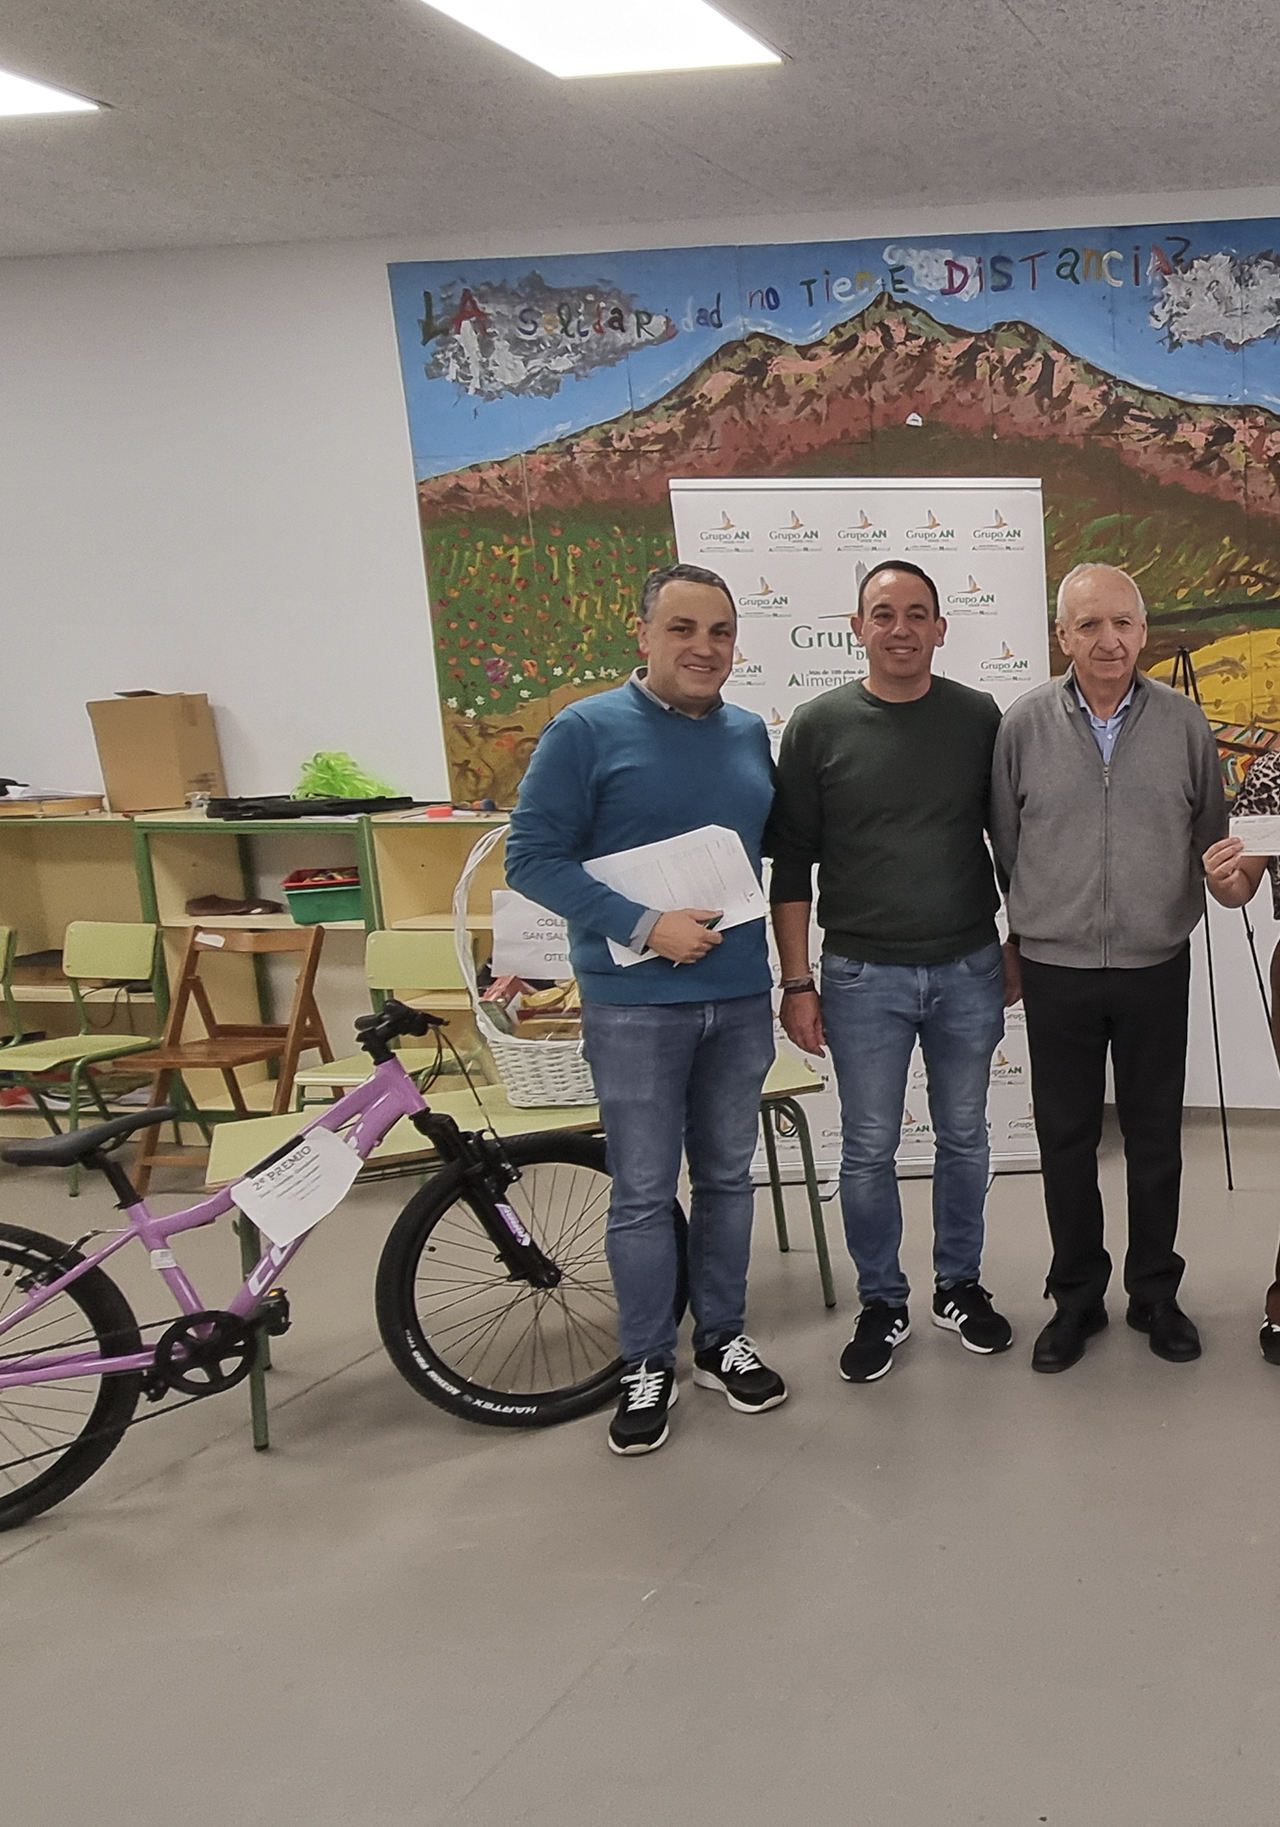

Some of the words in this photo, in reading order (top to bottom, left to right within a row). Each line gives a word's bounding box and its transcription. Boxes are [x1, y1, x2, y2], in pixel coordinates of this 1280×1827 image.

[417, 288, 489, 346] LA
[700, 531, 731, 541] Grupo
[734, 531, 750, 539] AN
[769, 530, 800, 541] Grupo
[803, 530, 818, 539] AN
[837, 530, 869, 541] Grupo
[871, 530, 887, 538] AN
[906, 530, 936, 540] Grupo
[939, 529, 954, 538] AN
[973, 530, 1003, 540] Grupo
[1006, 529, 1021, 538] AN
[738, 597, 770, 607] Grupo
[772, 596, 788, 605] AN
[947, 595, 977, 605] Grupo
[979, 594, 995, 603] AN
[790, 624, 862, 656] Grup
[746, 665, 762, 673] AN
[981, 661, 1010, 671] Grupo
[1013, 660, 1028, 669] AN
[536, 918, 567, 927] COLE
[522, 931, 544, 940] SAN
[545, 932, 568, 941] SAL
[1008, 1066, 1022, 1075] AN
[915, 1125, 930, 1133] AN
[267, 1145, 312, 1182] PREMIO
[471, 1399, 538, 1414] HARTEX
